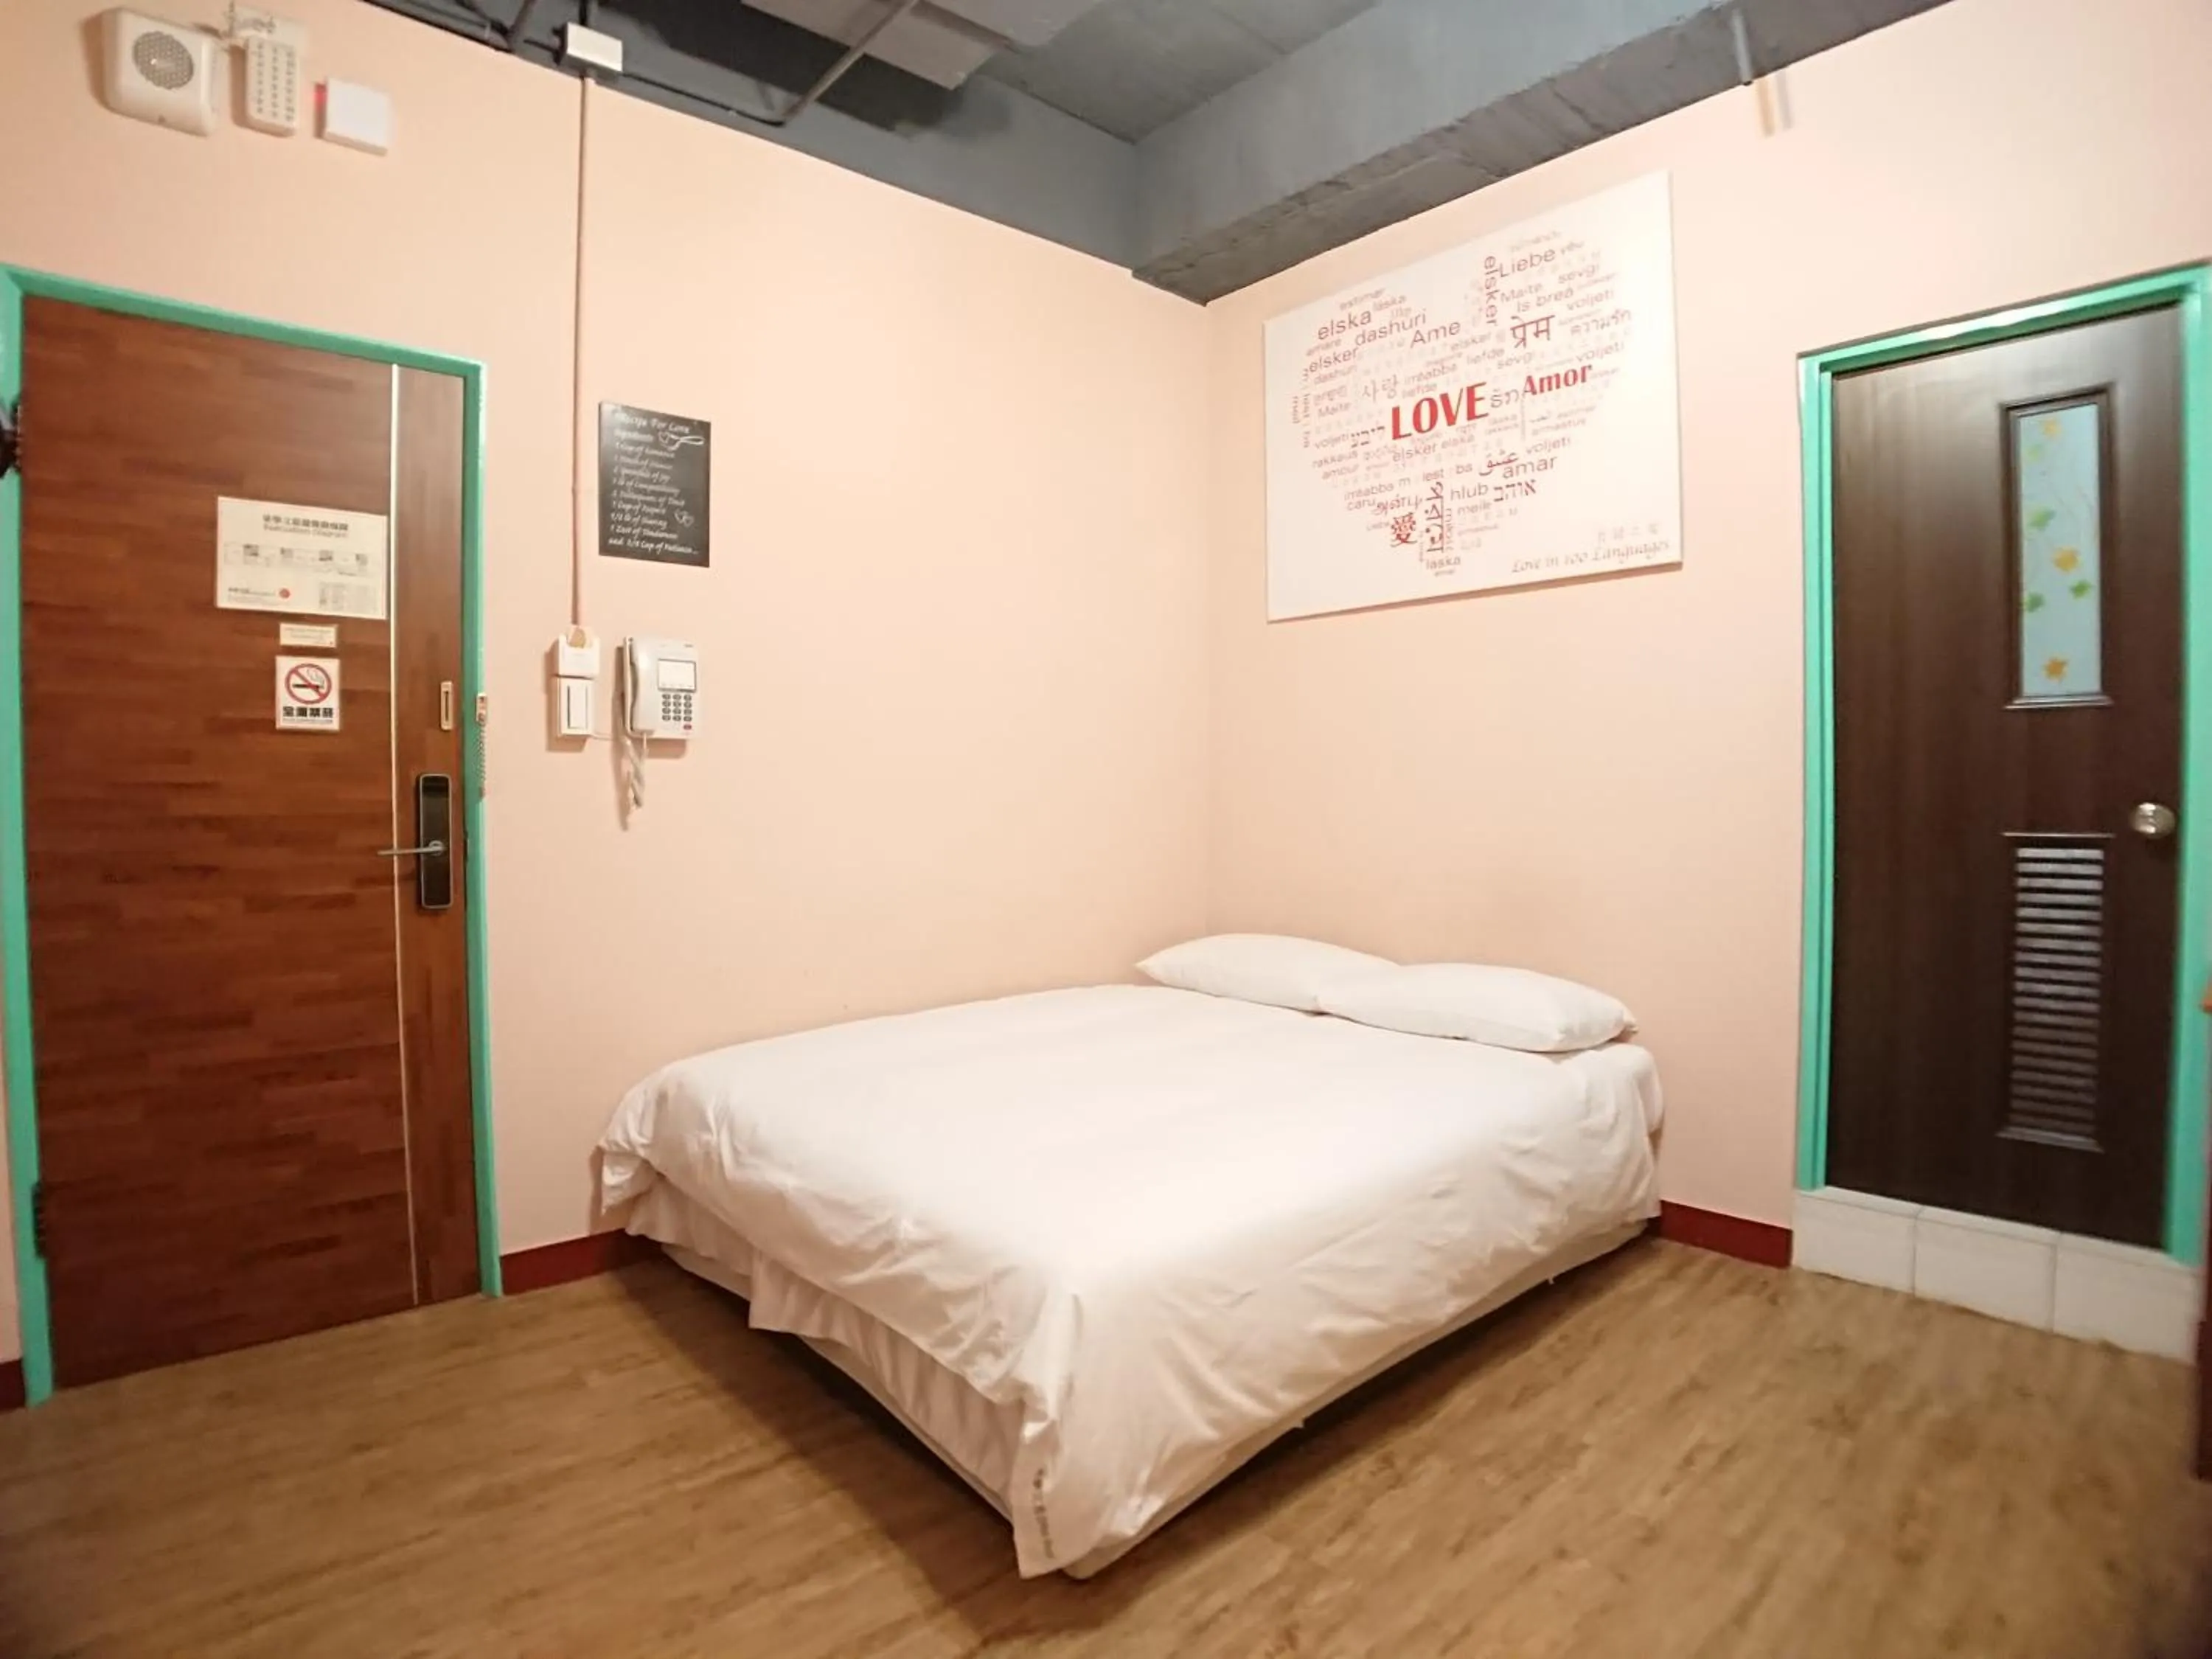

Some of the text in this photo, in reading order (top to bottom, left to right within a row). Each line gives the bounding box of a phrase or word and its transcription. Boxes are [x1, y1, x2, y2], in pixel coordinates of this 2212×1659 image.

[1500, 249, 1555, 277] Liebe
[1484, 256, 1500, 326] elsker
[1318, 310, 1371, 340] elska
[1355, 307, 1427, 346] dashuri
[1411, 321, 1461, 349] Ame
[1510, 315, 1556, 349] प्रेम
[1309, 347, 1359, 372] elsker
[1363, 375, 1399, 403] 사랑
[1523, 364, 1593, 399] Amor
[1391, 382, 1489, 440] LOVE
[651, 418, 667, 430] For
[669, 421, 690, 434] Love
[1503, 456, 1557, 479] amar
[1347, 499, 1376, 512] caru
[1450, 481, 1489, 501] hlub
[1390, 512, 1419, 548] 愛
[1512, 558, 1542, 574] Love
[1545, 557, 1559, 568] in
[1592, 540, 1669, 565] Languages
